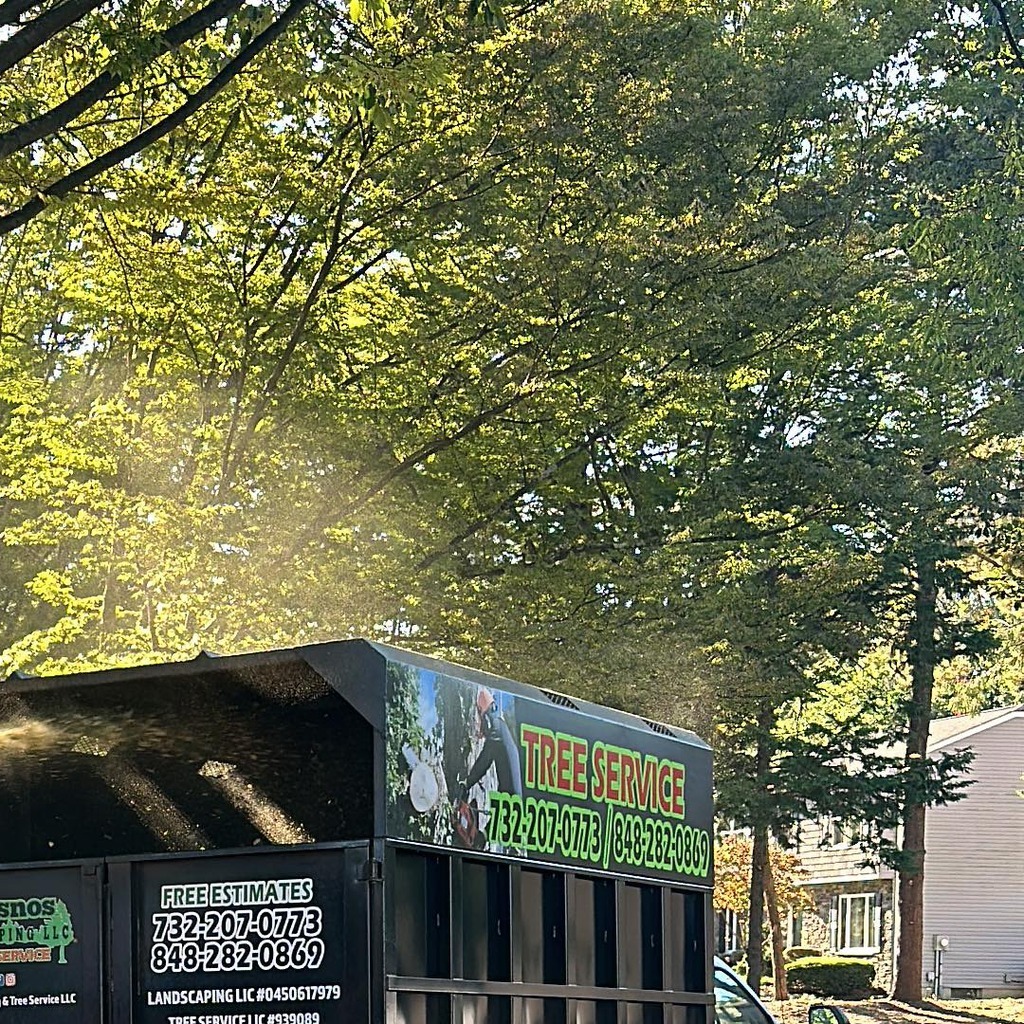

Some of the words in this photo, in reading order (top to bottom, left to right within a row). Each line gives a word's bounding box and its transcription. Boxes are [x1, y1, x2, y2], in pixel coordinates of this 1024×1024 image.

[520, 723, 588, 800] TREE
[591, 740, 686, 820] SERVICE
[487, 791, 602, 863] 732-207-0773
[613, 811, 710, 878] 848-282-0869
[161, 883, 208, 908] FREE
[210, 878, 313, 906] ESTIMATES
[42, 924, 70, 941] LLC
[152, 906, 323, 942] 732-207-0773
[150, 938, 325, 973] 848-282-0869
[2, 997, 9, 1006] &
[9, 996, 28, 1006] Tree
[28, 994, 60, 1005] Service
[60, 993, 77, 1004] LLC
[147, 989, 233, 1006] LANDSCAPING
[235, 988, 255, 1003] LIC
[256, 985, 341, 1002] #0450617979
